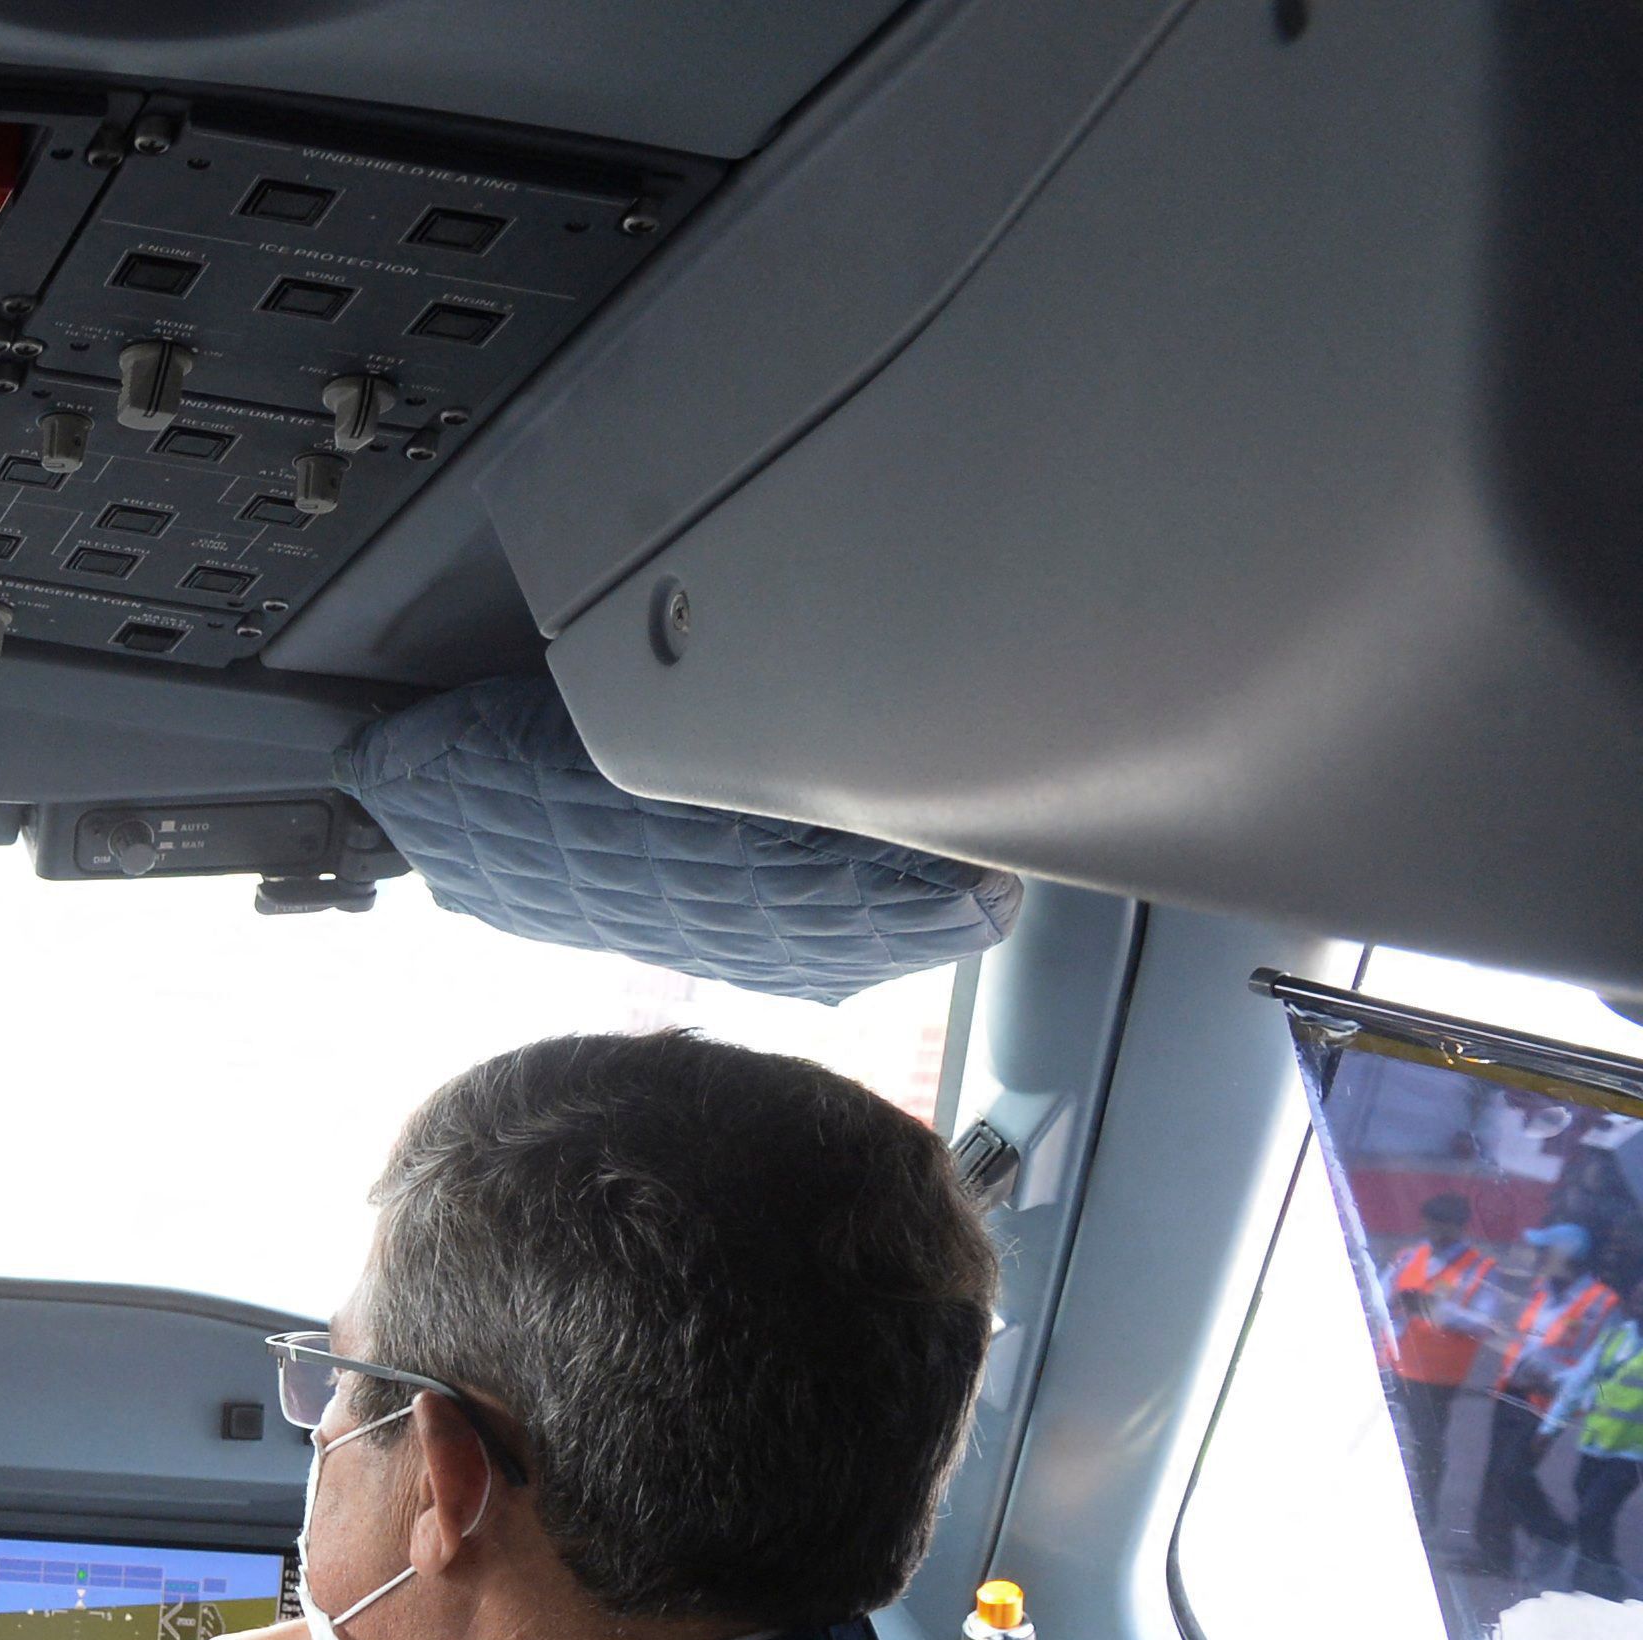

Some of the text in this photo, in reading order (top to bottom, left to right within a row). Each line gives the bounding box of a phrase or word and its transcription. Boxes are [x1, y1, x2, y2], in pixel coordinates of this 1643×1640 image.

[302, 148, 518, 193] WINDSHIELD HEATING
[259, 242, 419, 277] ICE PROTECTION
